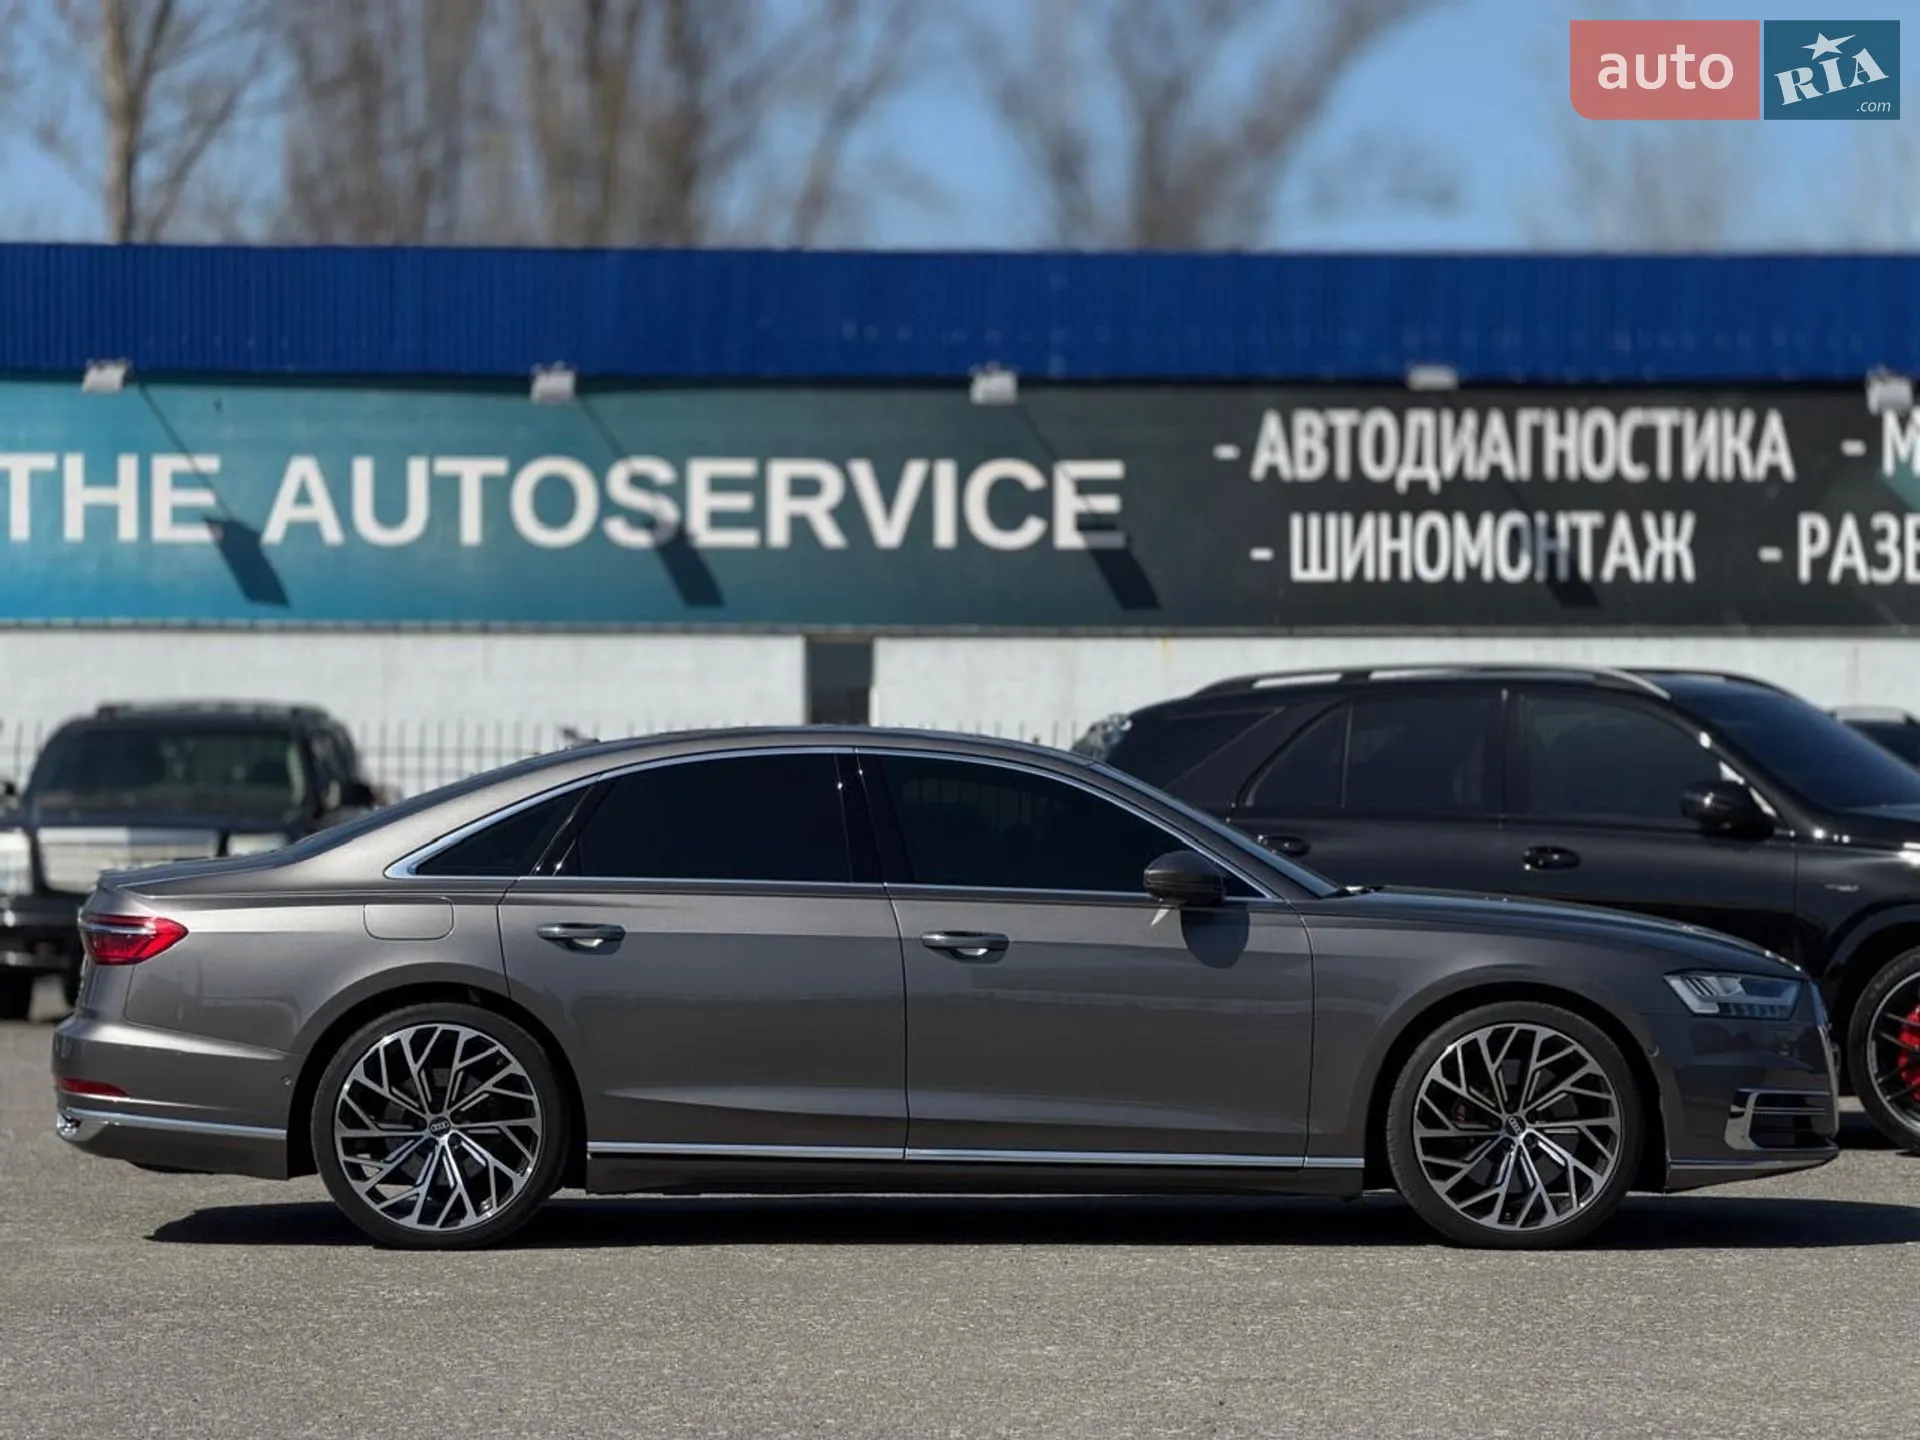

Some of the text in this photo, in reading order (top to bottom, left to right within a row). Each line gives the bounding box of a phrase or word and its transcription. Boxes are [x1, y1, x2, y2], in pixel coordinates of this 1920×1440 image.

[1250, 407, 1797, 495] АВТОДИАГНОСТИКА
[0, 452, 1125, 550] THE AUTOSERVICE
[1289, 510, 1697, 583] ШИНОМОНТАЖ
